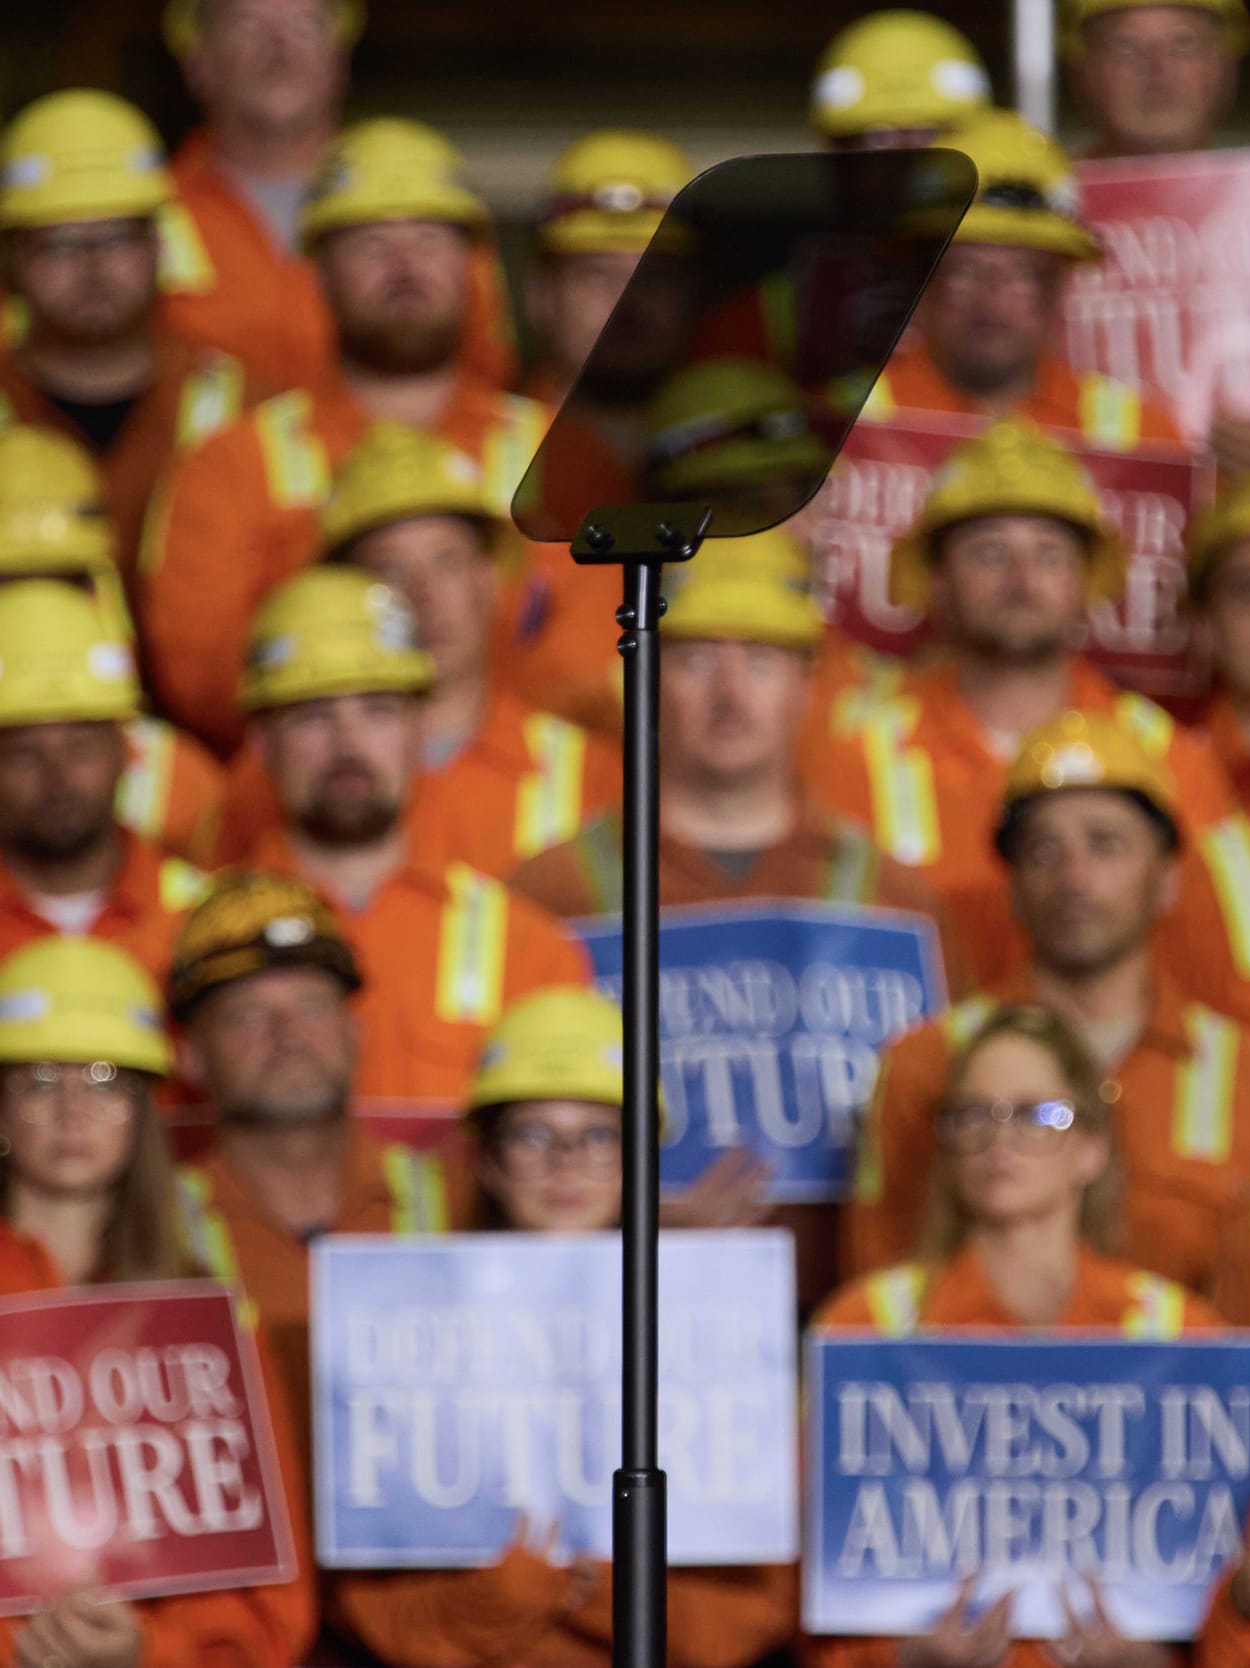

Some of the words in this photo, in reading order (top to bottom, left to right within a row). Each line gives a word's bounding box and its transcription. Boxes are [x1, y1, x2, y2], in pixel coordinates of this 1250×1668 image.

[658, 960, 800, 1037] END
[658, 1033, 881, 1149] TUR
[89, 1342, 241, 1425] OUR
[838, 1381, 1146, 1481] INVEST
[0, 1417, 263, 1560] TURE
[838, 1477, 1243, 1585] AMERICA
